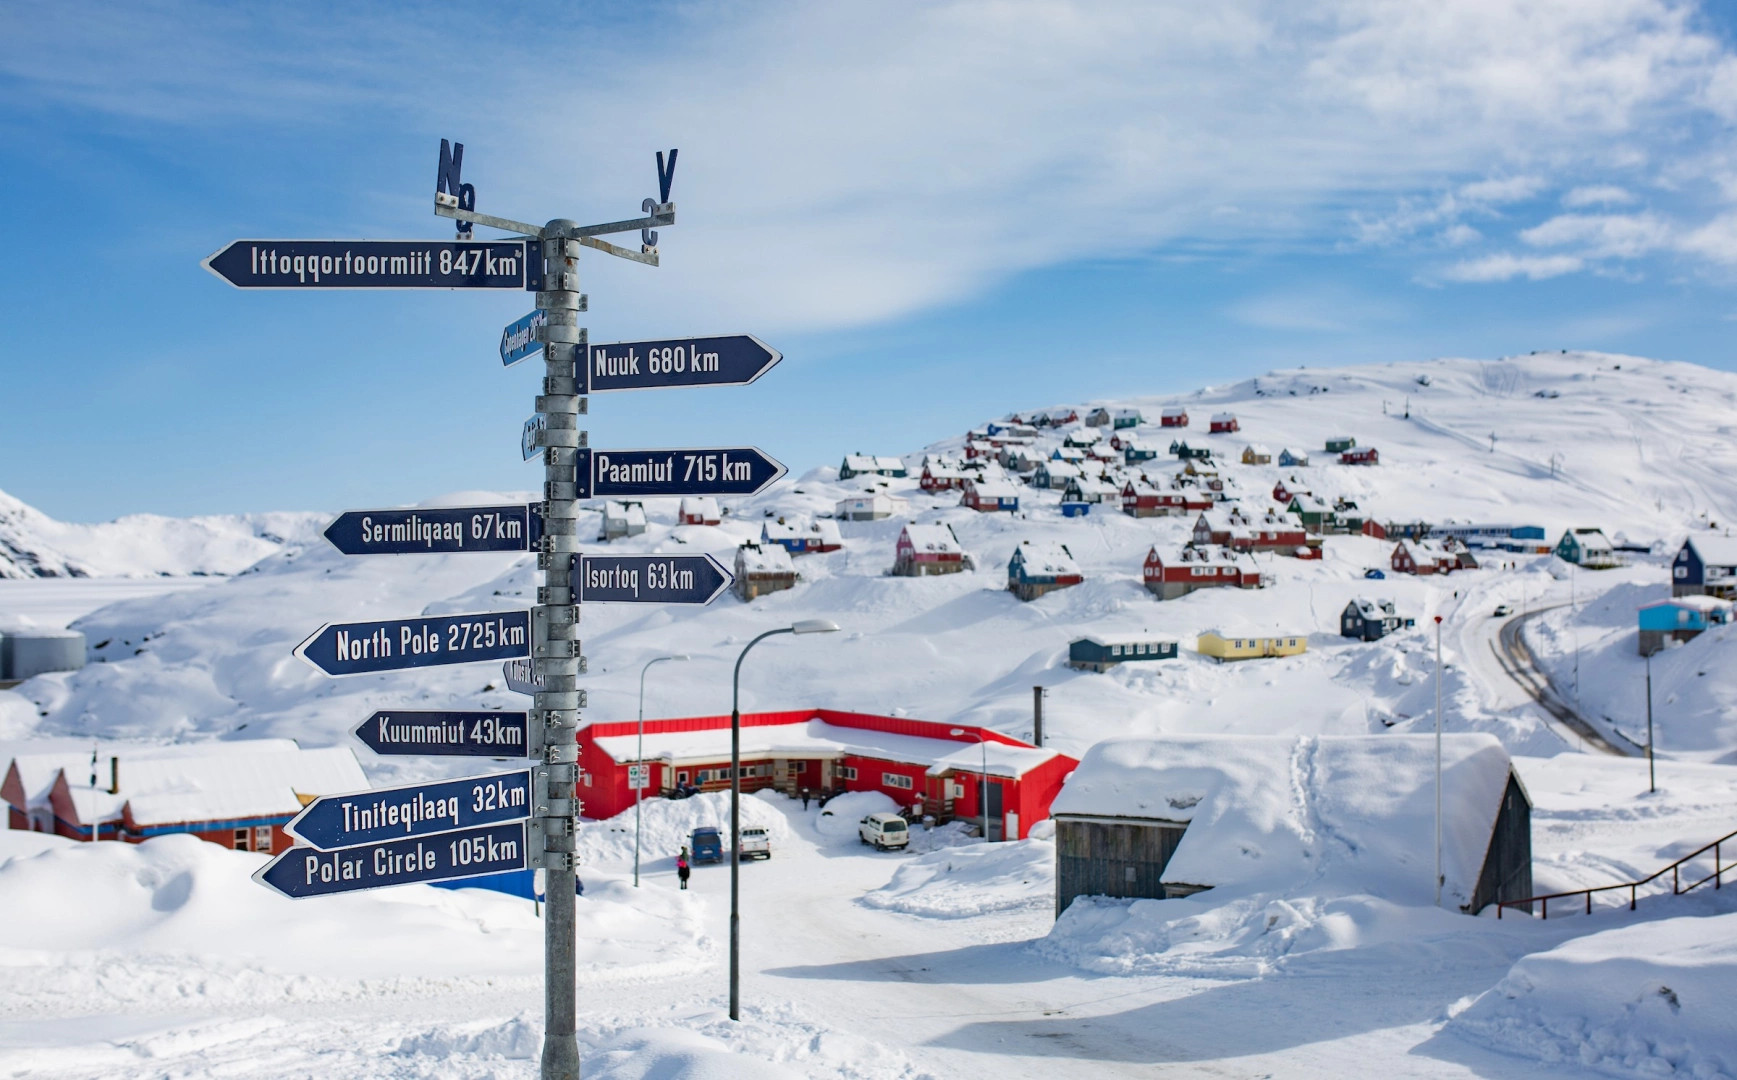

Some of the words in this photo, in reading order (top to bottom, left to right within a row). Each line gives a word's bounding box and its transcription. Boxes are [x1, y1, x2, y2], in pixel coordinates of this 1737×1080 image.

[437, 138, 464, 198] N
[656, 149, 678, 204] V
[252, 246, 431, 283] Ittoqqortoormiit
[596, 347, 640, 377] Nuuk
[598, 455, 673, 483] Paamiut
[362, 513, 463, 548] Sermiliqaaq
[586, 560, 639, 598] Isortoq
[336, 626, 391, 661] North
[400, 624, 439, 656] Pole
[379, 716, 465, 744] Kuummiut
[341, 792, 459, 833] Tiniteqilaaq
[305, 852, 363, 885] Polar
[374, 842, 436, 876] Circle
